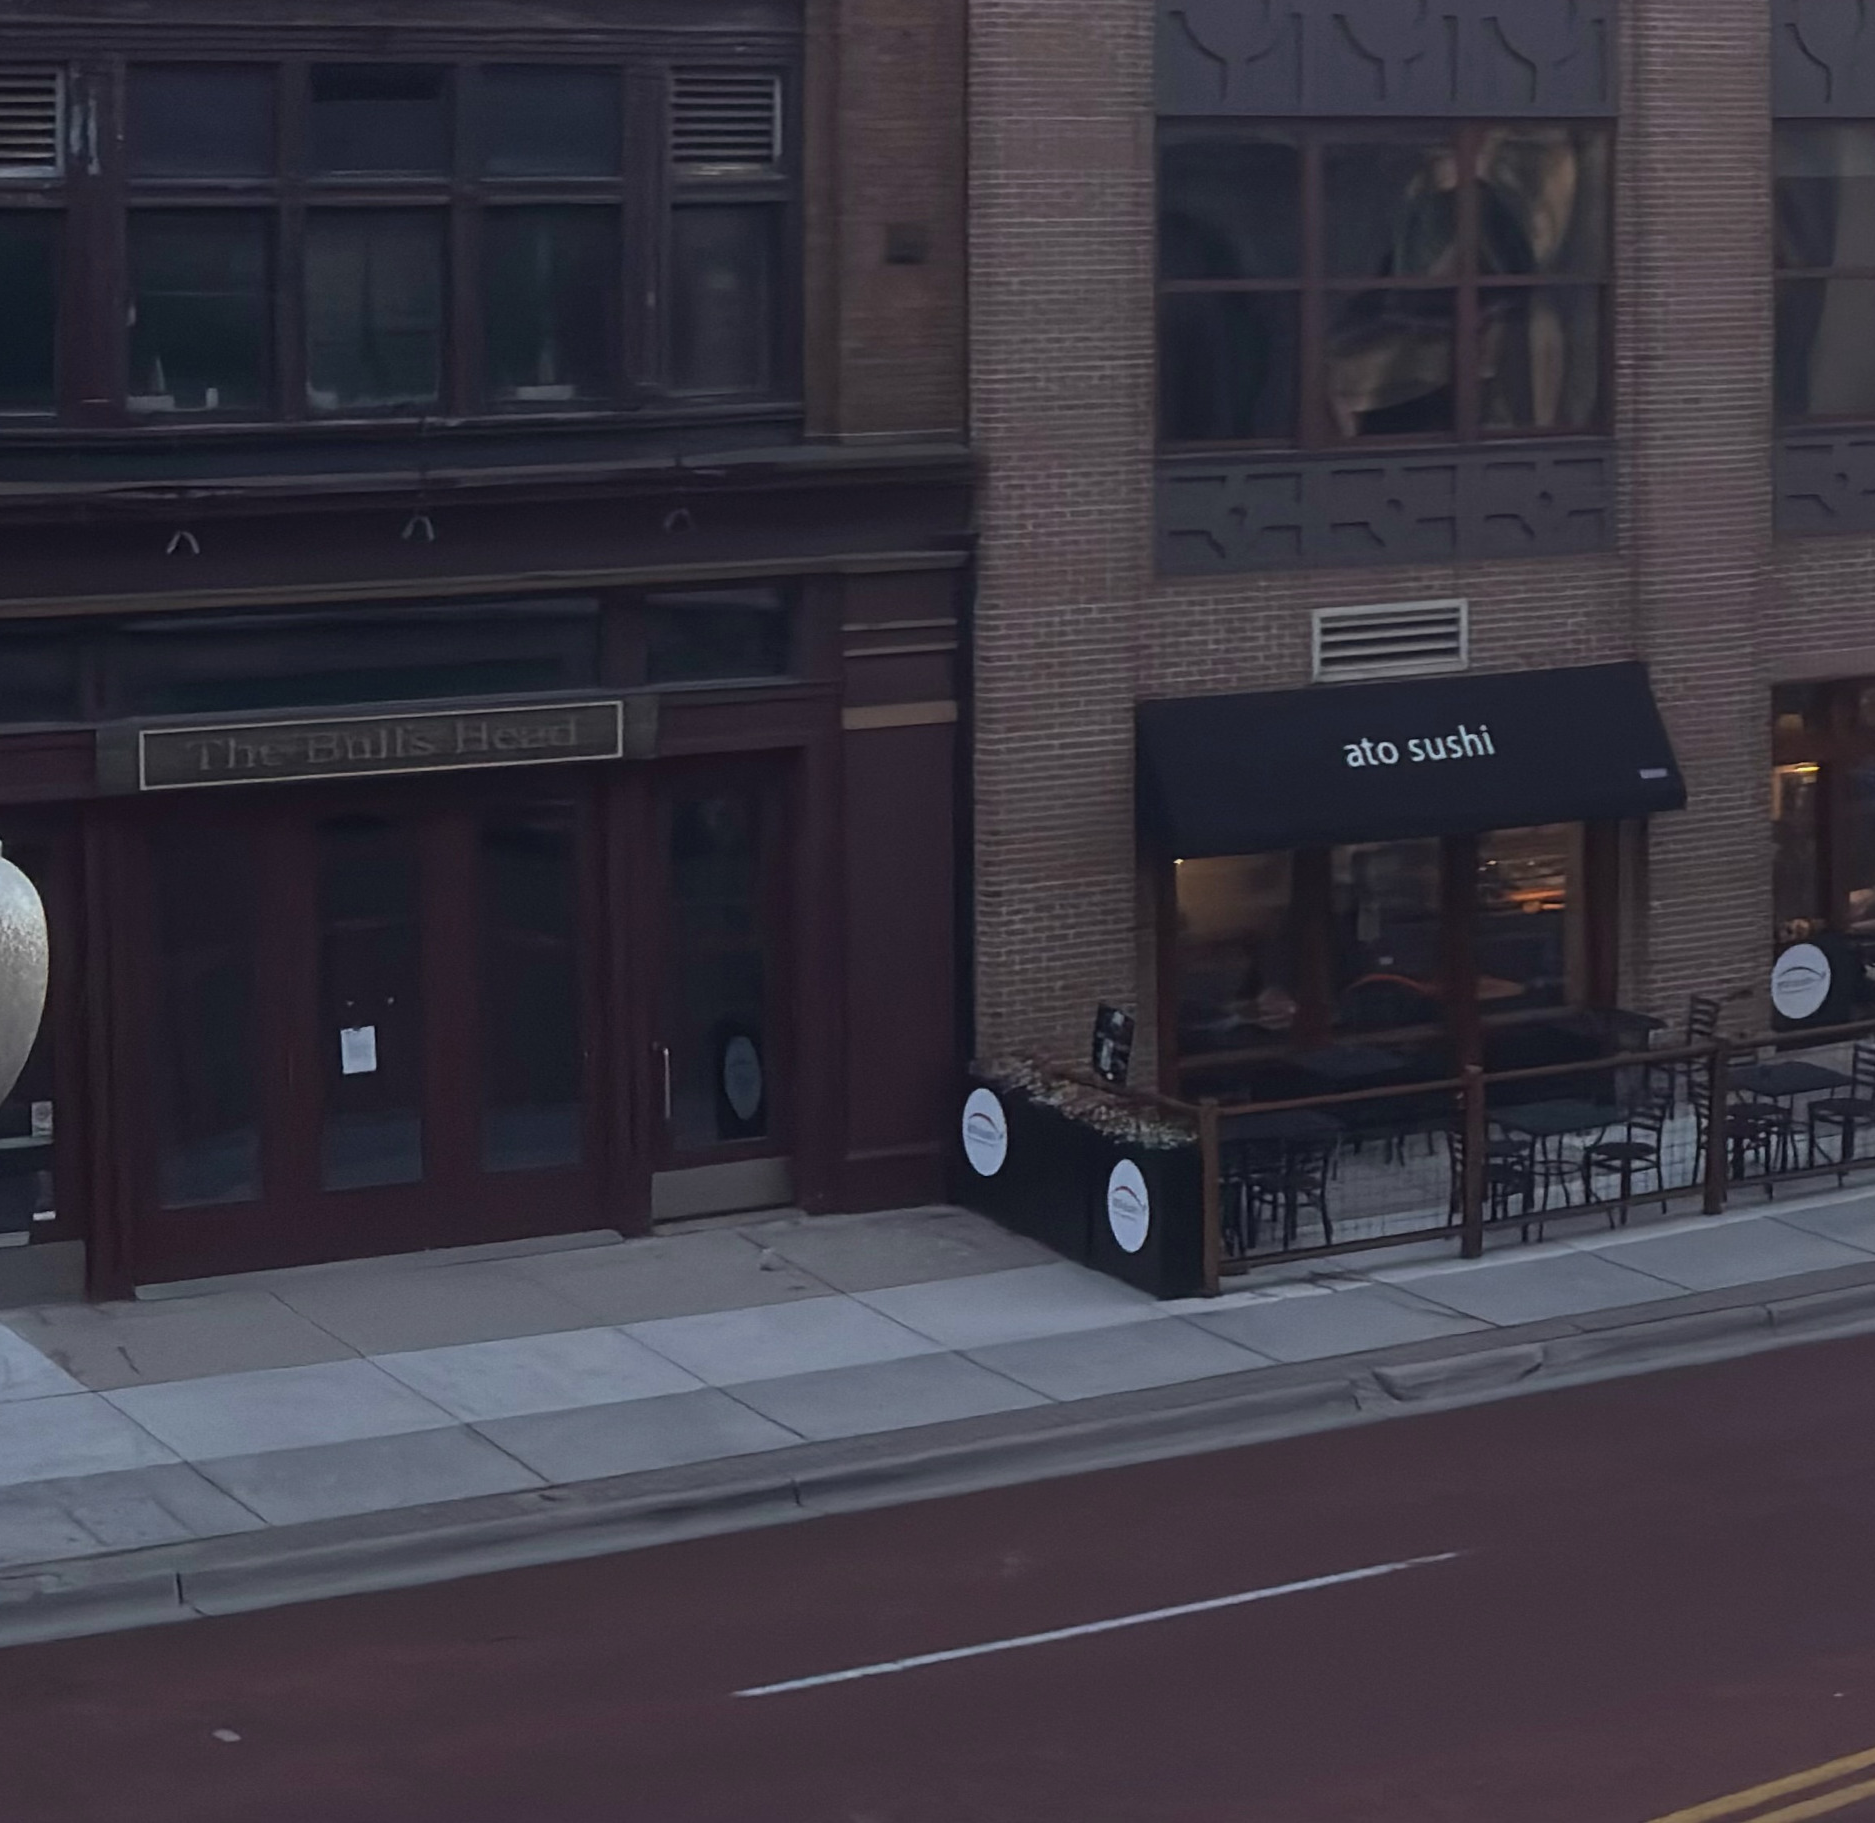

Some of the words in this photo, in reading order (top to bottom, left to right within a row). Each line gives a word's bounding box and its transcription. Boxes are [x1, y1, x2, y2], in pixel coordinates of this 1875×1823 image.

[186, 738, 283, 771] The
[455, 717, 579, 754] Head
[1342, 736, 1400, 769] ato
[1408, 724, 1496, 763] sushi
